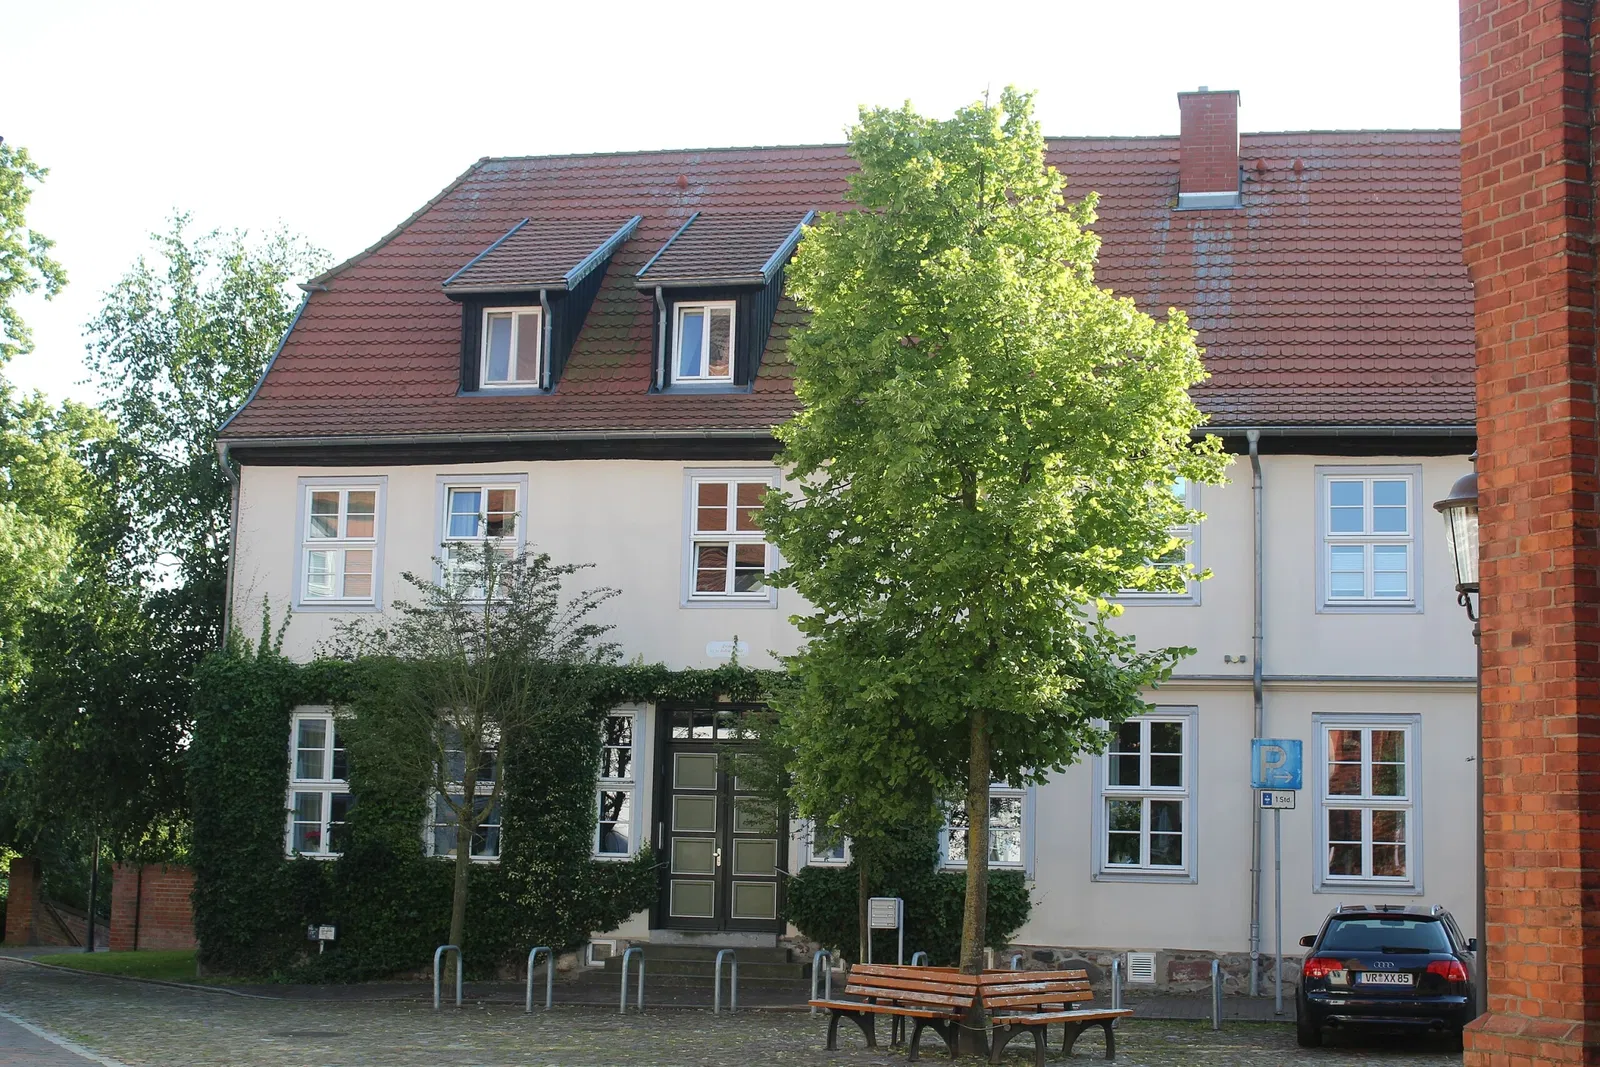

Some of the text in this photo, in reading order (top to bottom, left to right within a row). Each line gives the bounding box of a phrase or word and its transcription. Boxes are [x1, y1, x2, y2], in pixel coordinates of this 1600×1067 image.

[1260, 745, 1287, 783] P
[1365, 973, 1409, 983] VR XX 85
